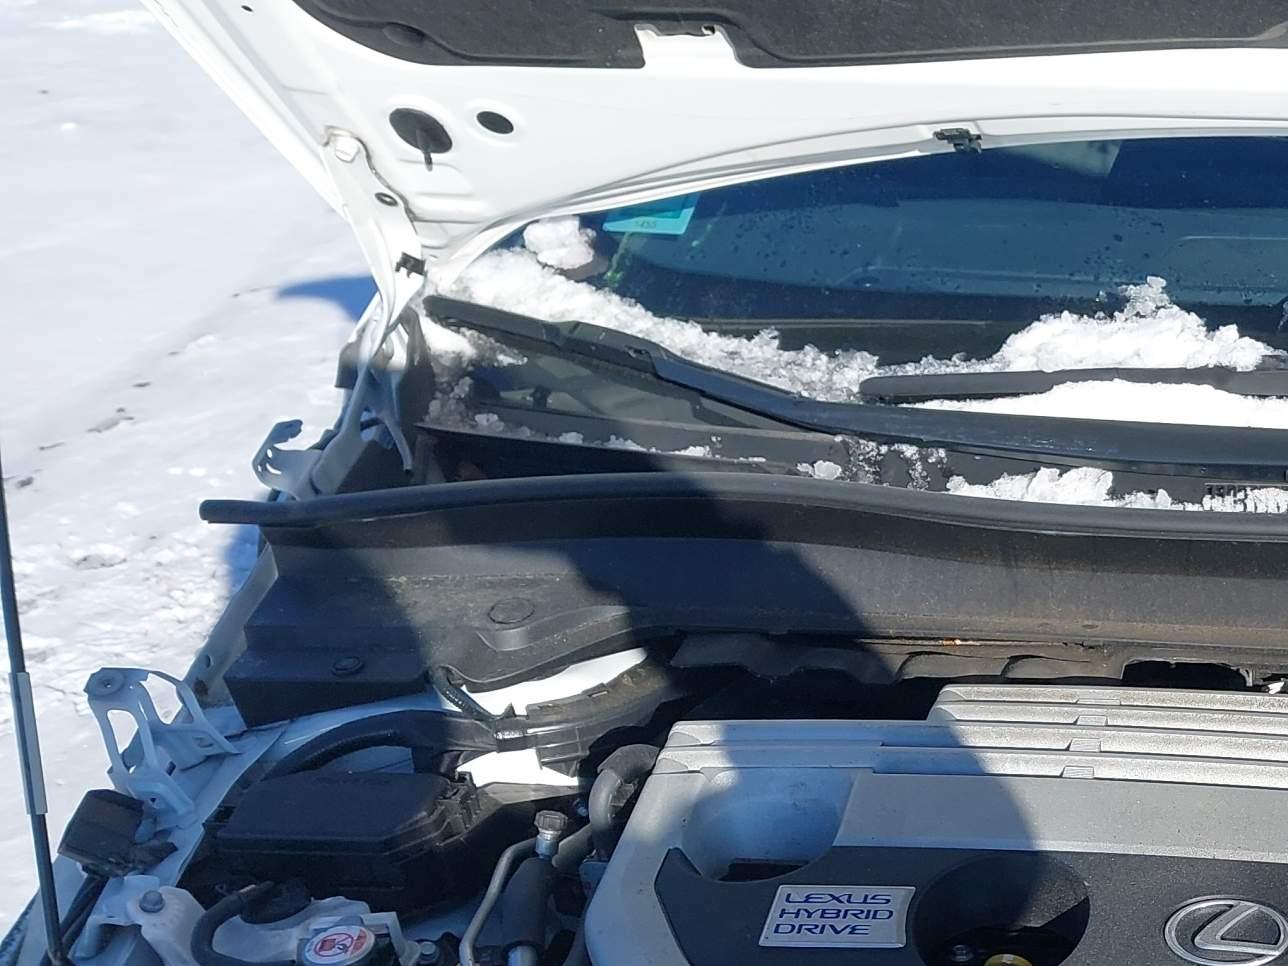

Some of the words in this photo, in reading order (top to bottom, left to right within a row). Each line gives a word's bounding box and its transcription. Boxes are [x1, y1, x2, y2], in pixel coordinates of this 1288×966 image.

[784, 892, 892, 905] LEXUS
[778, 907, 894, 920] HYBRID
[773, 923, 873, 936] DRIVE
